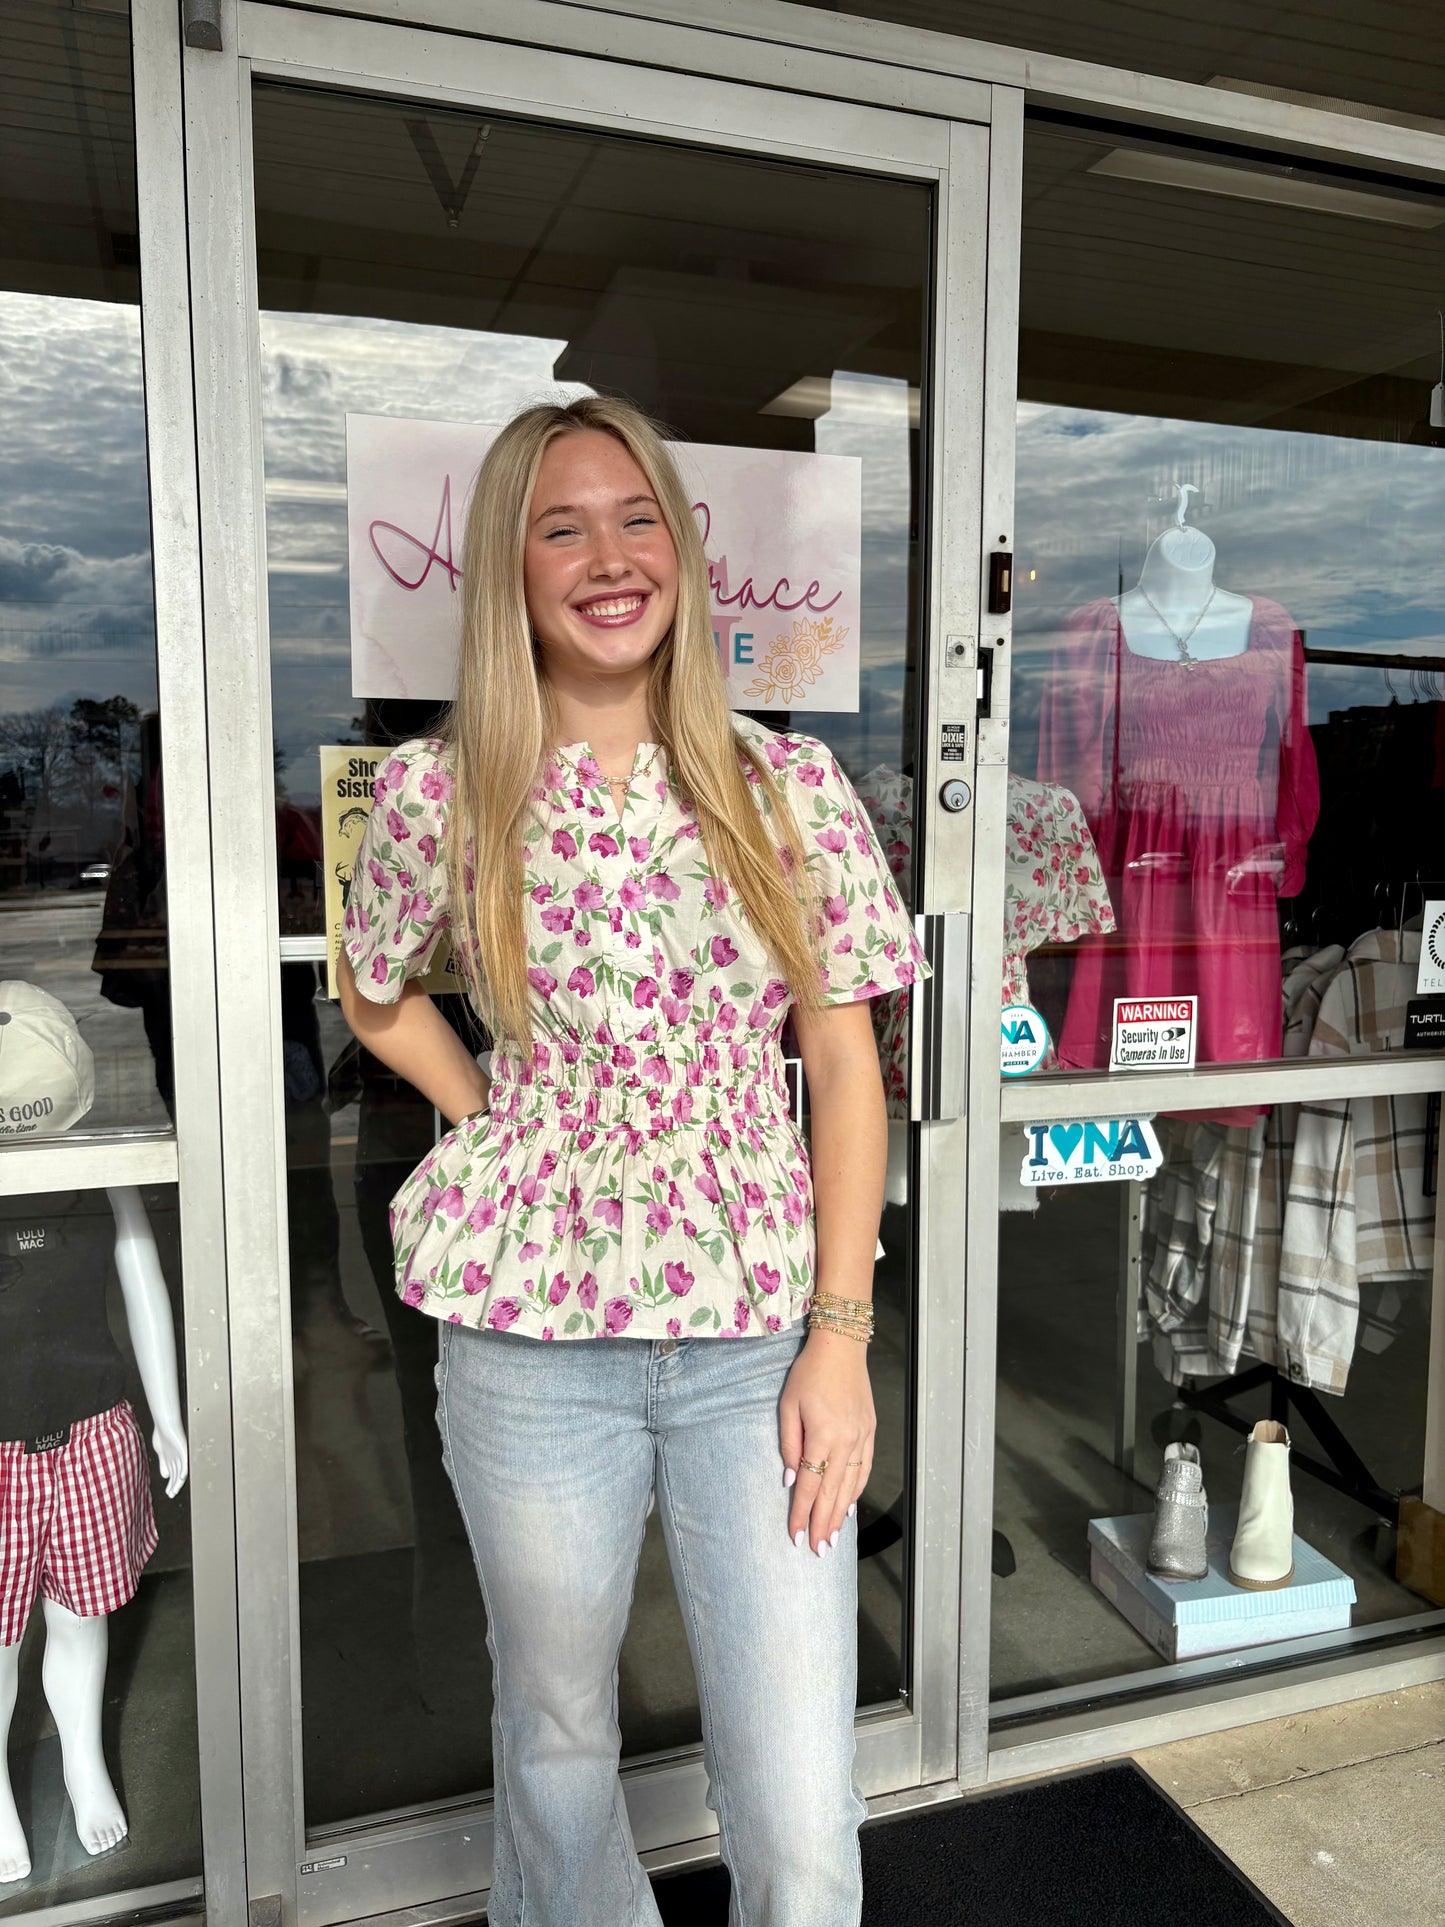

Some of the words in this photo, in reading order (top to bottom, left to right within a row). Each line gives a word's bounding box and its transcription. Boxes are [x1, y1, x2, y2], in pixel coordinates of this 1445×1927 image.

[942, 732, 965, 743] DIXIE
[348, 758, 379, 777] Sho
[336, 778, 376, 798] Siste
[1424, 979, 1442, 987] TEL
[1121, 1003, 1188, 1022] WARNING
[1409, 1013, 1445, 1024] TURTL
[1121, 1028, 1158, 1046] Security
[1001, 1050, 1037, 1058] HAMBER
[1120, 1047, 1156, 1062] Cameras
[1159, 1046, 1167, 1060] In
[1170, 1045, 1185, 1060] Use
[9, 1096, 54, 1122] GOOD
[15, 1123, 38, 1133] time
[1029, 1125, 1049, 1166] I
[1083, 1119, 1152, 1164] NA
[1031, 1170, 1068, 1181] Live.
[1074, 1166, 1103, 1178] Eat.
[1108, 1164, 1149, 1177] Shop.
[16, 1228, 45, 1241] LULU
[19, 1238, 44, 1250] MAC
[35, 1430, 64, 1444] LULU
[36, 1440, 61, 1451] MAC
